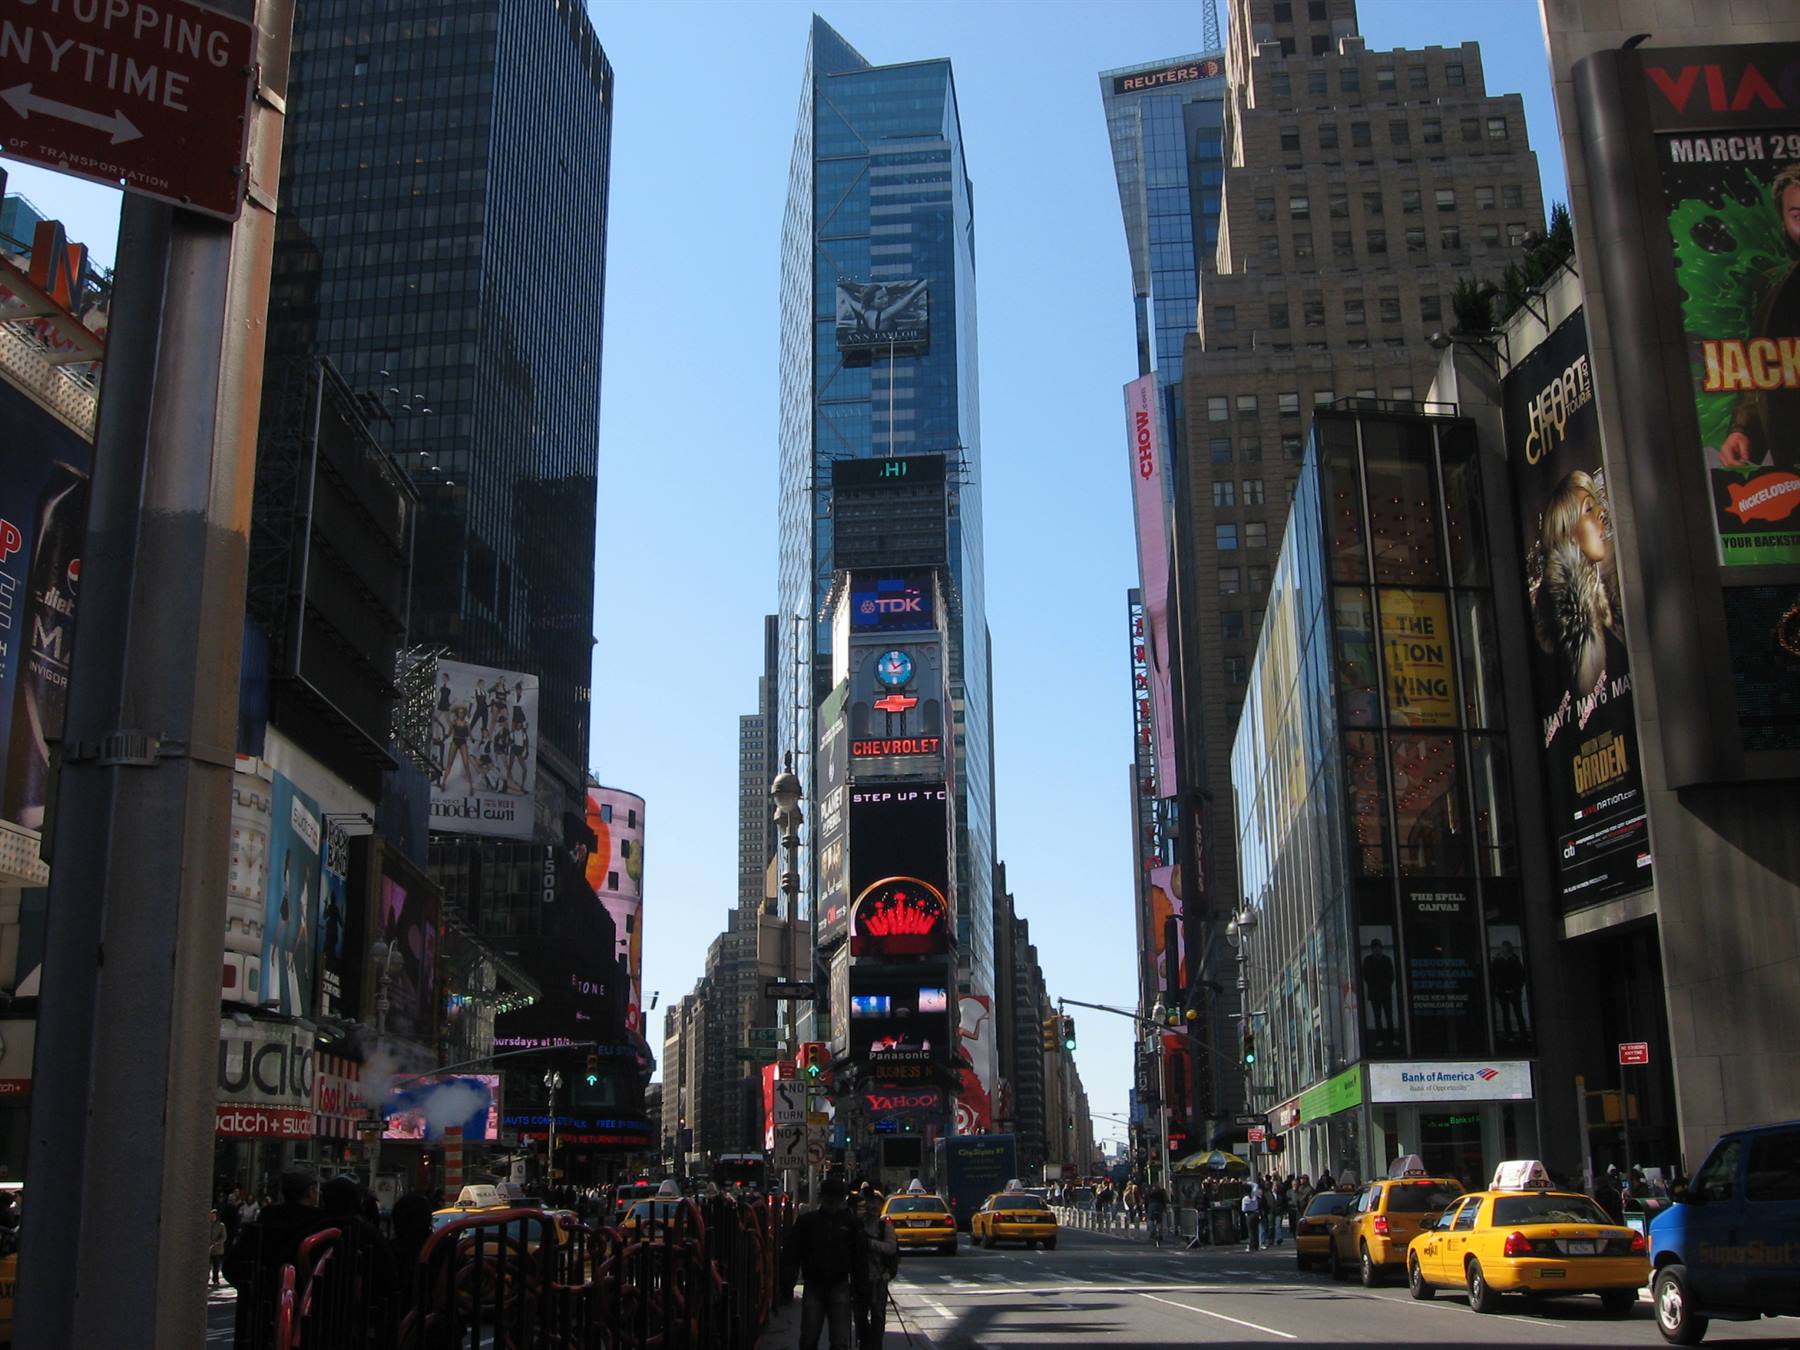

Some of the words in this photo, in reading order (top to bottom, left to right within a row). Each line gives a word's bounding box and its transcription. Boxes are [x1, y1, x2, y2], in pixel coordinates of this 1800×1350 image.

[18, 0, 229, 67] OPPING
[1124, 67, 1198, 91] REUTERS
[1670, 136, 1765, 163] MARCH
[10, 137, 29, 149] OF
[39, 144, 169, 190] TRANSPORTATION
[1722, 537, 1752, 549] YOUR
[875, 598, 921, 613] TDK
[1398, 616, 1435, 635] THE
[1391, 640, 1444, 672] LION
[1395, 676, 1449, 707] KING
[853, 738, 939, 756] CHEVROLET
[1574, 735, 1628, 795] GARDEN
[853, 793, 892, 803] STEP
[897, 792, 918, 801] UP
[430, 797, 480, 819] model
[544, 845, 555, 903] 1500
[1410, 893, 1434, 901] THE
[1418, 903, 1460, 911] CANVAS
[869, 1051, 930, 1061] Panasonic
[1402, 1072, 1426, 1082] Bank
[1426, 1072, 1435, 1081] of
[1437, 1072, 1475, 1081] America
[789, 1083, 805, 1093] NO
[778, 1111, 803, 1120] TURN
[777, 1128, 793, 1138] NO
[780, 1157, 804, 1165] TURN
